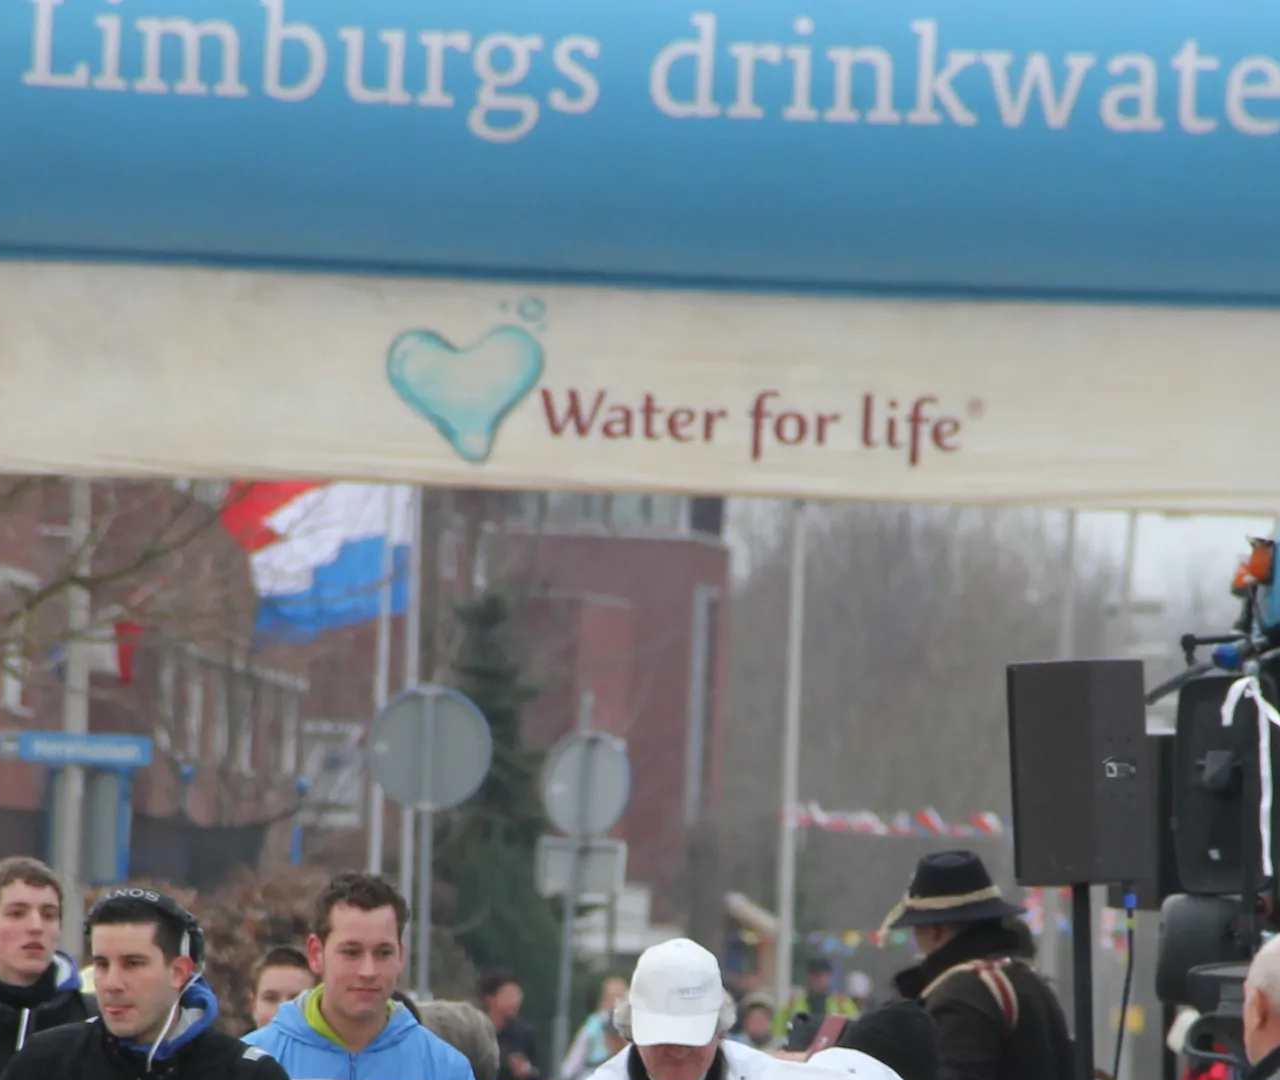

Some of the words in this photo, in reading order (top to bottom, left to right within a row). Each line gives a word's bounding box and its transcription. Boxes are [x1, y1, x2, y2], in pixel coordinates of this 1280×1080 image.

[23, 0, 601, 143] Limburgs
[540, 387, 727, 443] Water
[748, 389, 841, 463] for
